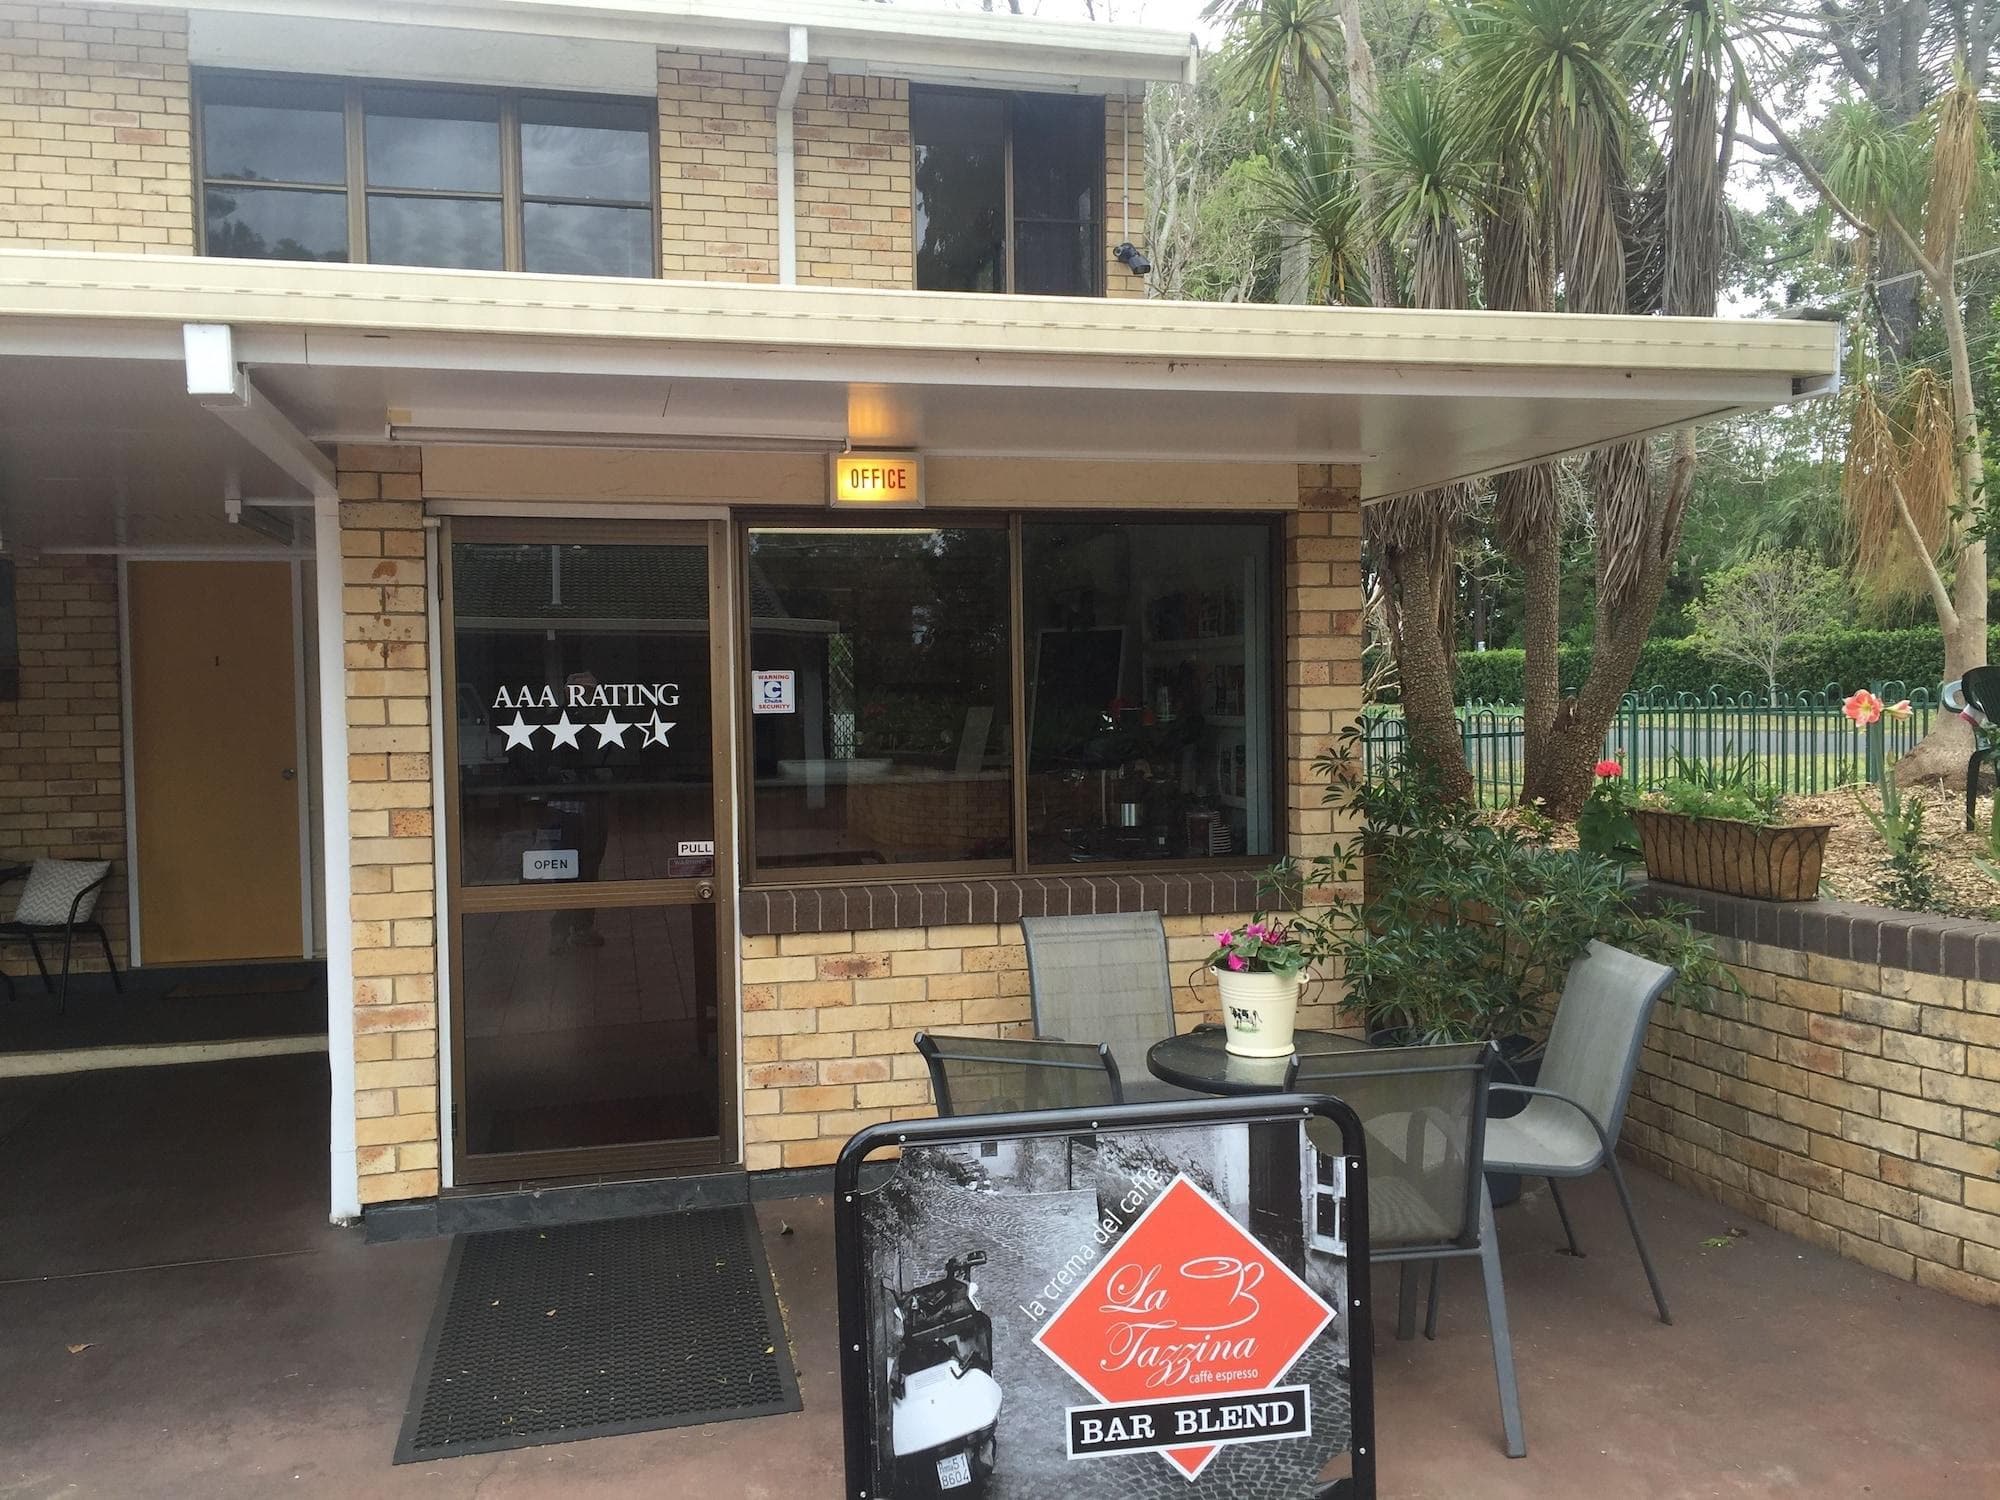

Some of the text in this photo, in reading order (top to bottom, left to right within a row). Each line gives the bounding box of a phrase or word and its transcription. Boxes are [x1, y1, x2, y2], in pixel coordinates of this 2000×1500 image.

[851, 468, 906, 489] OFFICE
[492, 683, 680, 709] AAA RATING
[681, 844, 712, 853] PULL
[534, 860, 568, 870] OPEN
[1019, 1300, 1047, 1321] la
[1044, 1244, 1096, 1300] crema
[1093, 1208, 1123, 1244] del
[1099, 1264, 1170, 1313] La
[1100, 1320, 1259, 1388] Tazzina
[1189, 1368, 1258, 1384] caffè espresso
[1080, 1401, 1295, 1444] BAR BLEND
